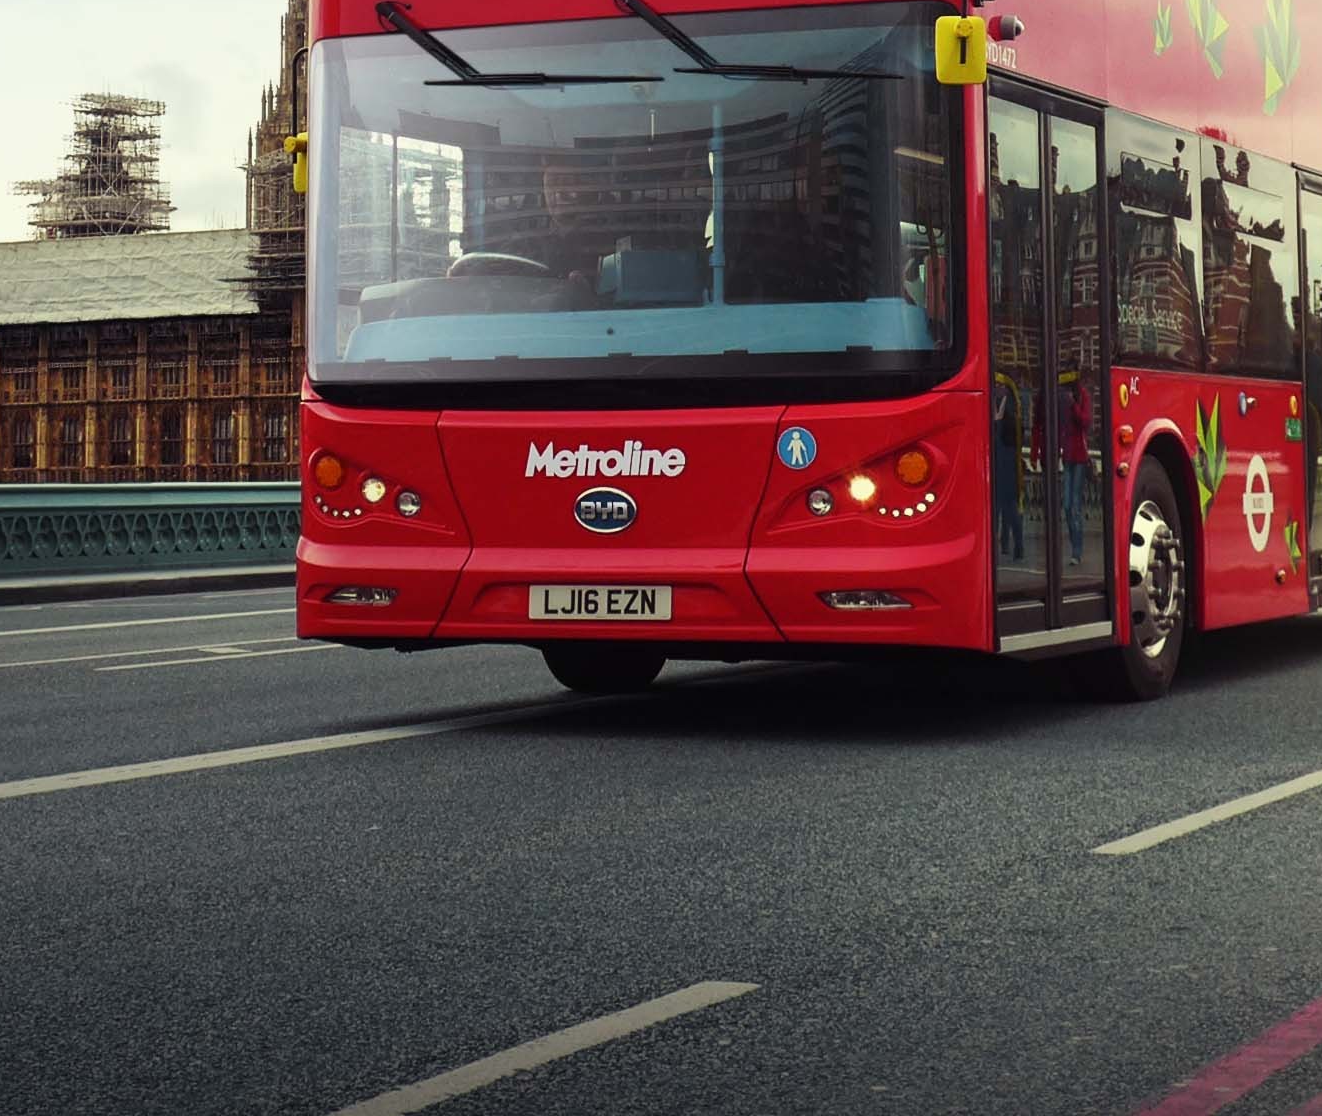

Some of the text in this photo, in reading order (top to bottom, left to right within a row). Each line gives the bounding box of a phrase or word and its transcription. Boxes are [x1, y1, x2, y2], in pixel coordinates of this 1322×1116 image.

[525, 440, 687, 478] Metroline
[580, 500, 629, 521] BYD
[543, 588, 657, 615] LJ16 EZN
